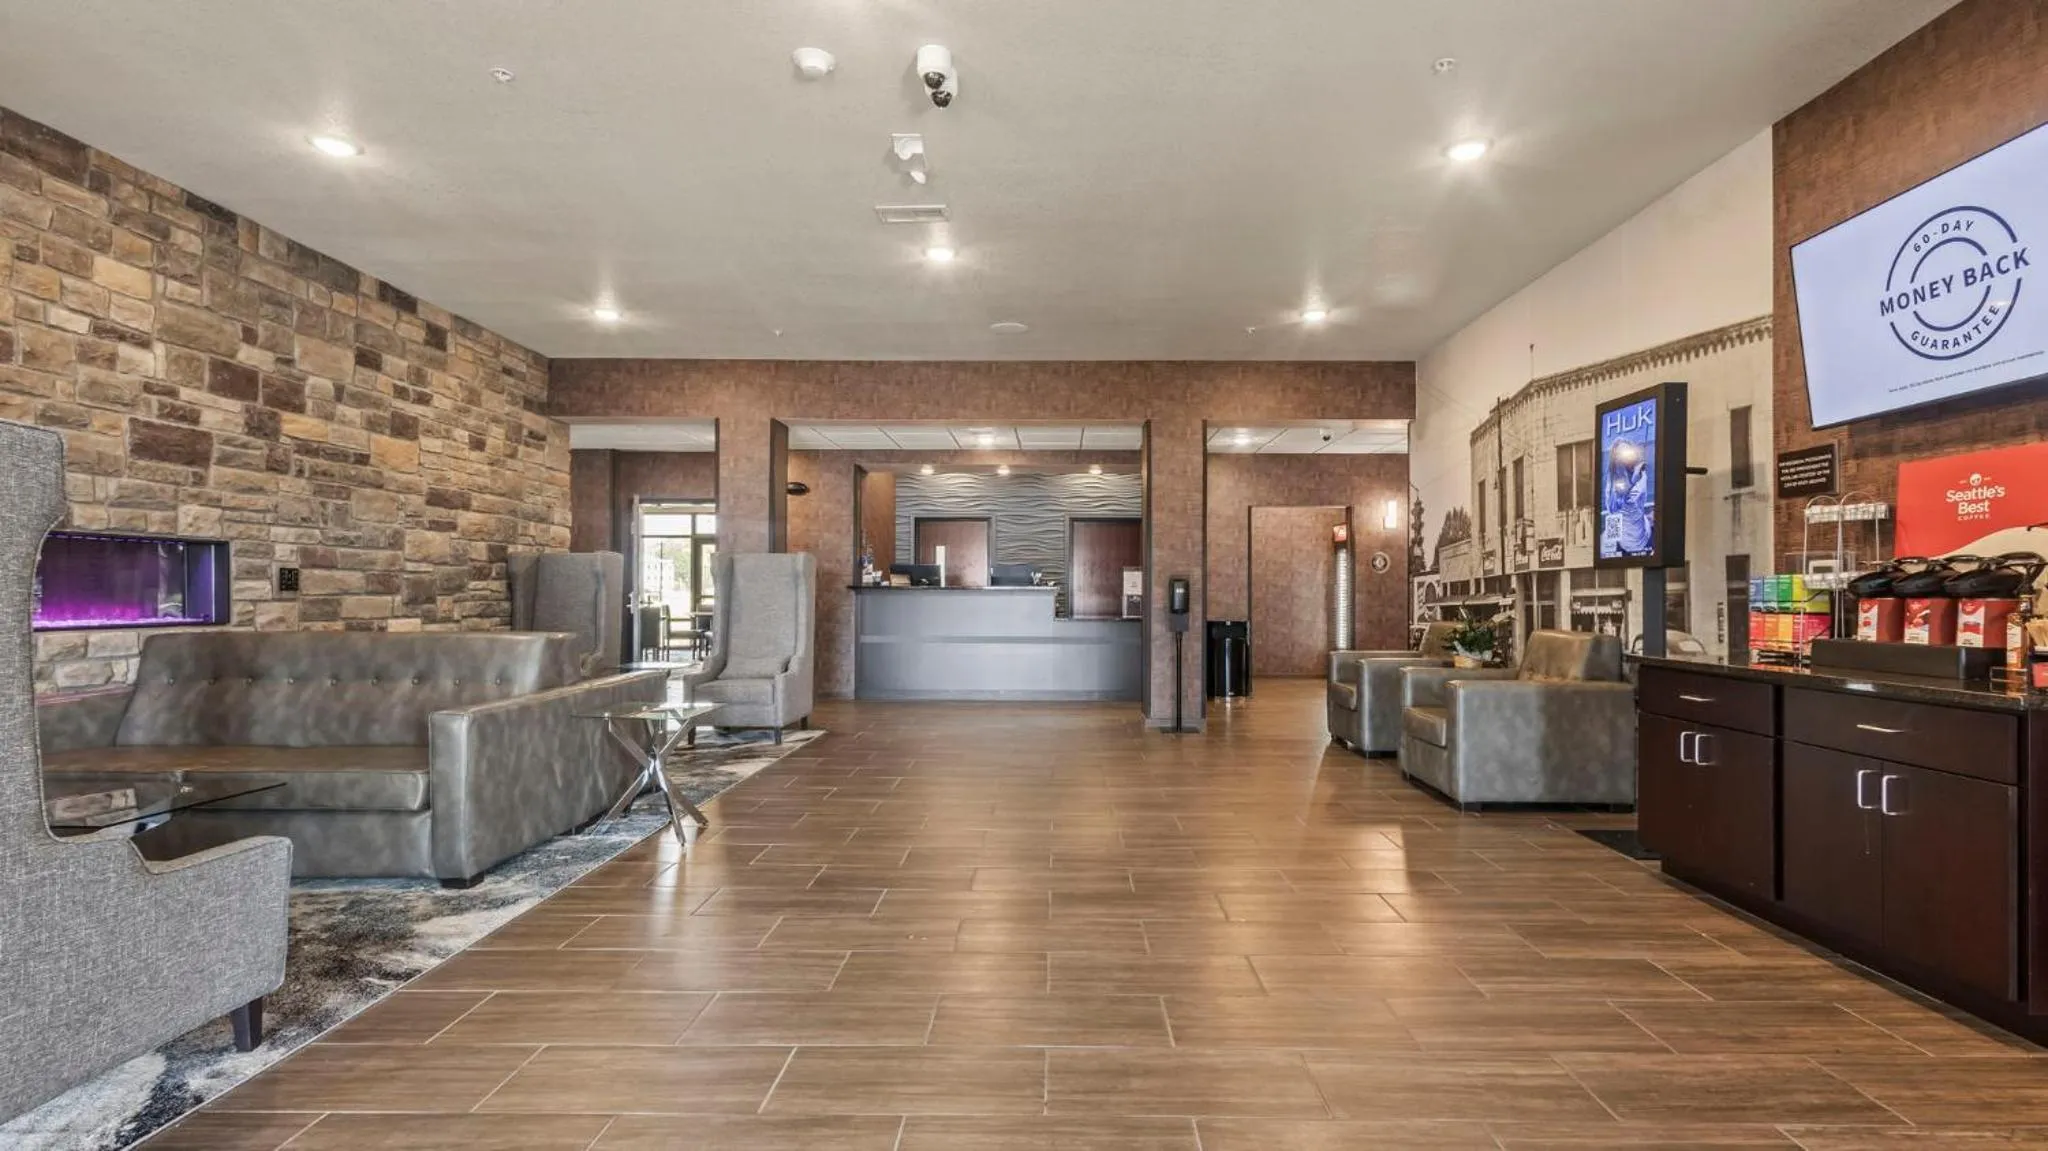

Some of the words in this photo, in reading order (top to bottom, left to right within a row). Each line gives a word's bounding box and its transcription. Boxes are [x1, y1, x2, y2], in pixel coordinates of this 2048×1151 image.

[1913, 220, 1974, 252] 60-DAY
[1880, 275, 1954, 316] MONEY
[1963, 247, 2031, 287] BACK
[1911, 305, 1999, 350] GUARANTEE
[1946, 485, 2005, 502] Seattle's
[1958, 500, 1990, 514] Best
